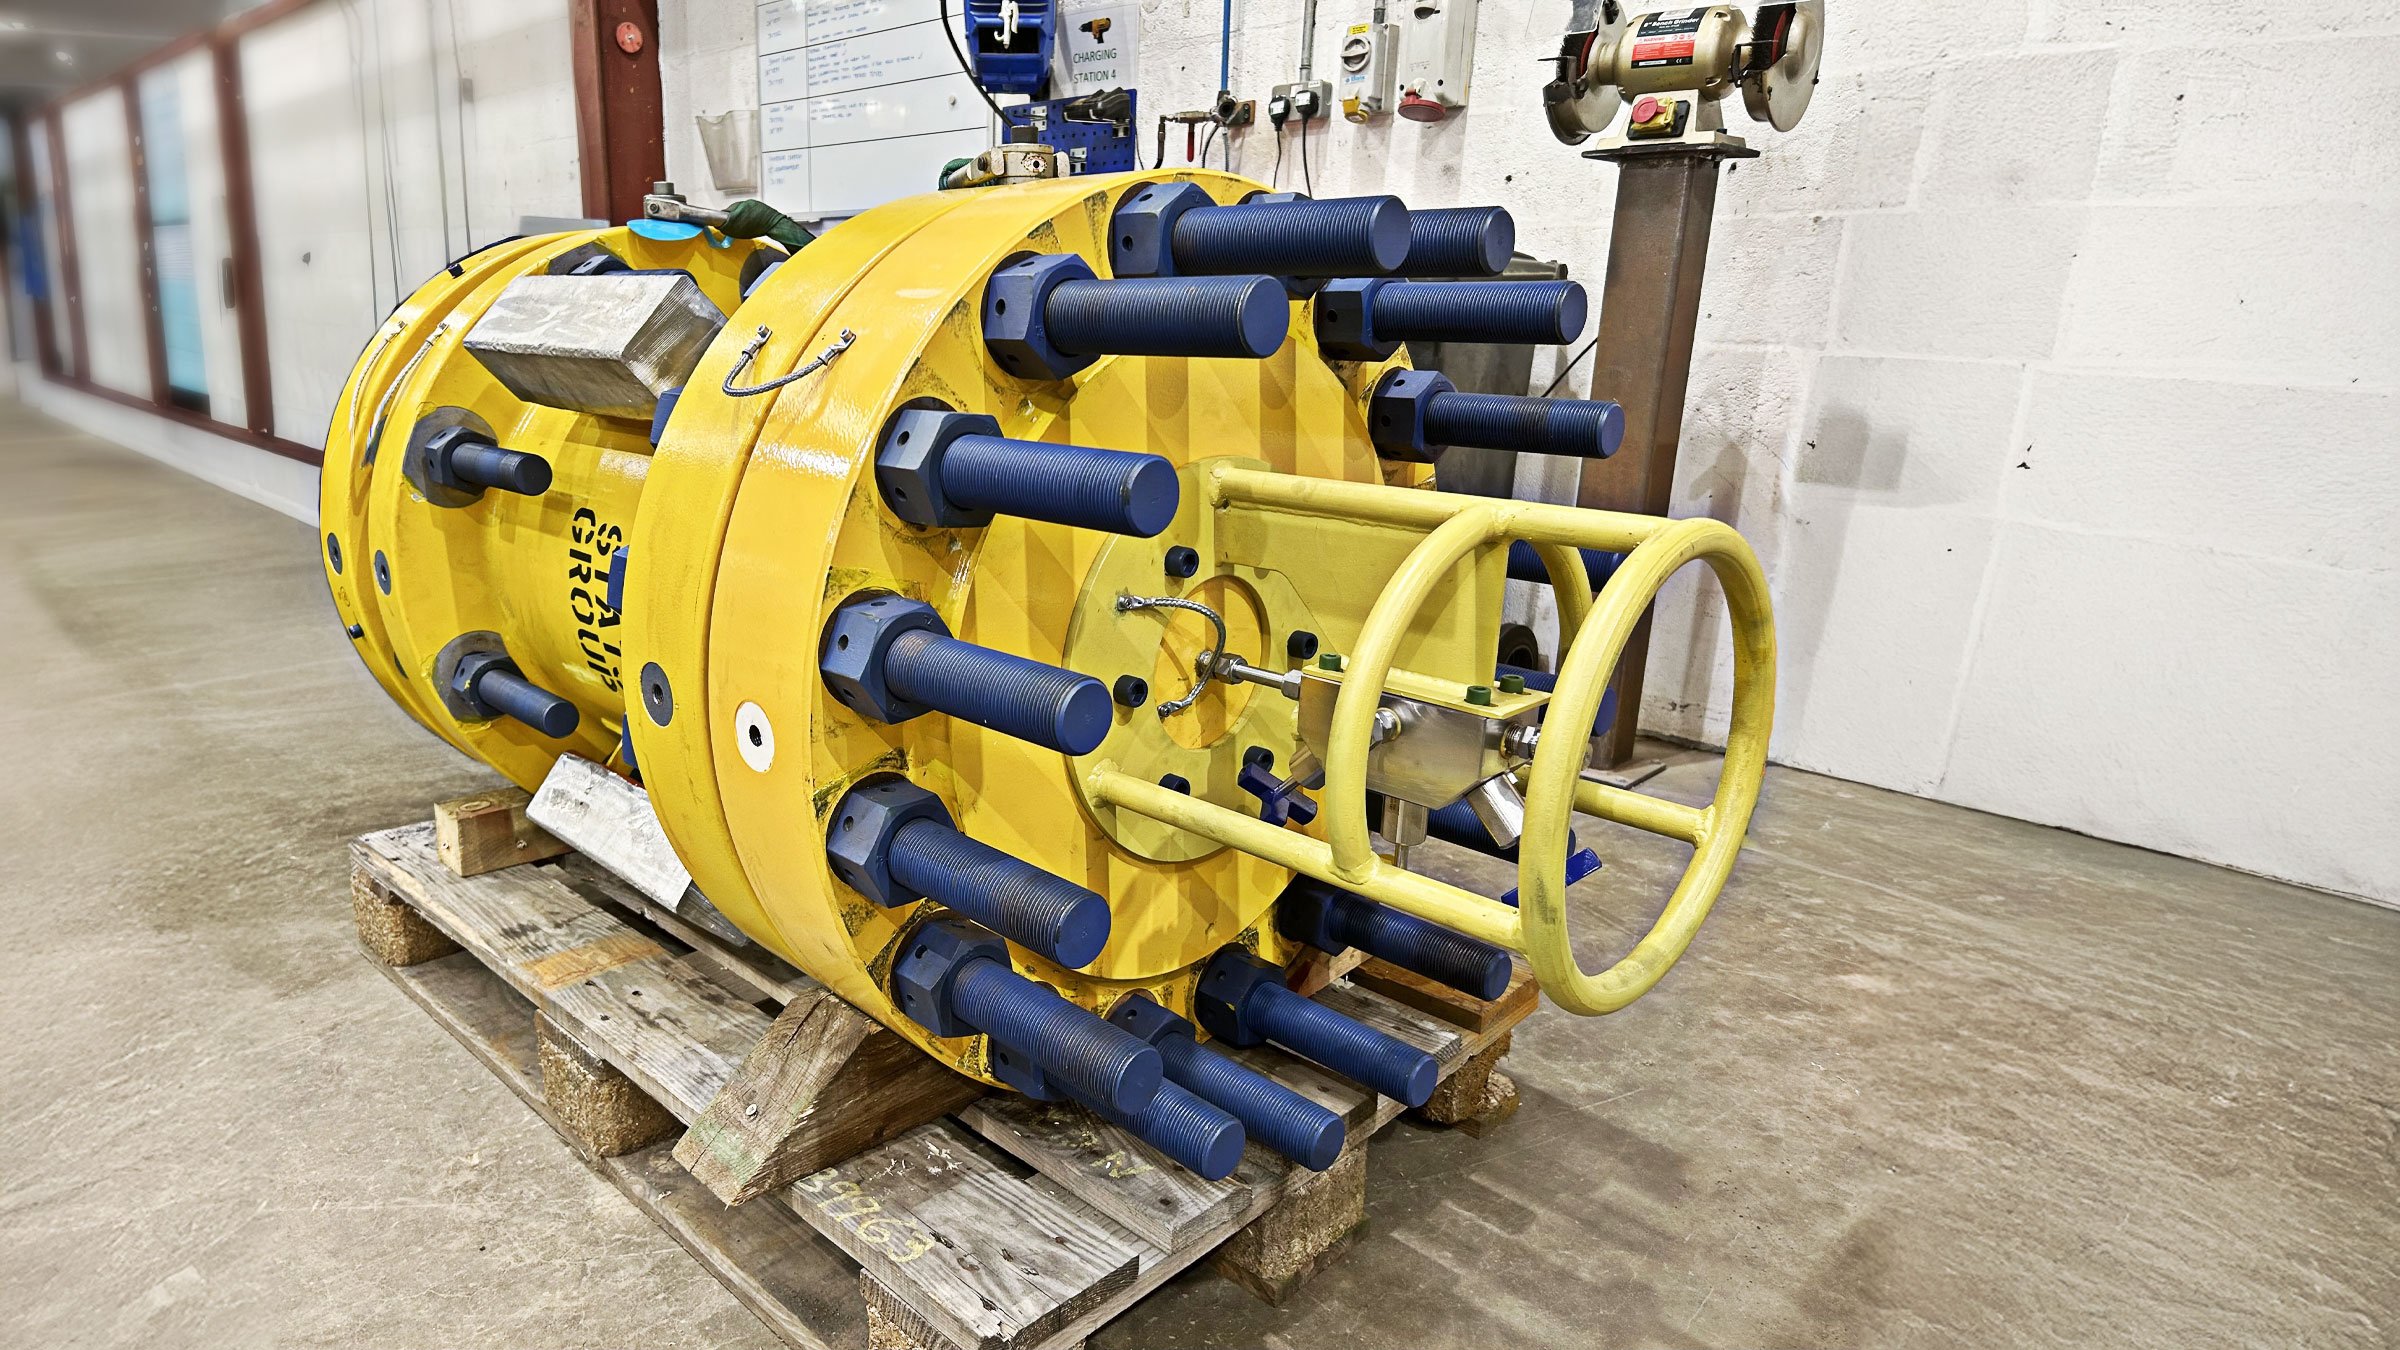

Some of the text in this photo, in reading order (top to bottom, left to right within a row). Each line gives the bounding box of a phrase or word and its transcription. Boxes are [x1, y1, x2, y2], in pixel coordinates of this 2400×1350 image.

[1674, 17, 1700, 25] Grinder
[1073, 48, 1117, 63] CHARGING
[1073, 69, 1116, 84] STATION 4
[569, 507, 618, 692] GROUP
[595, 523, 623, 692] SAT
